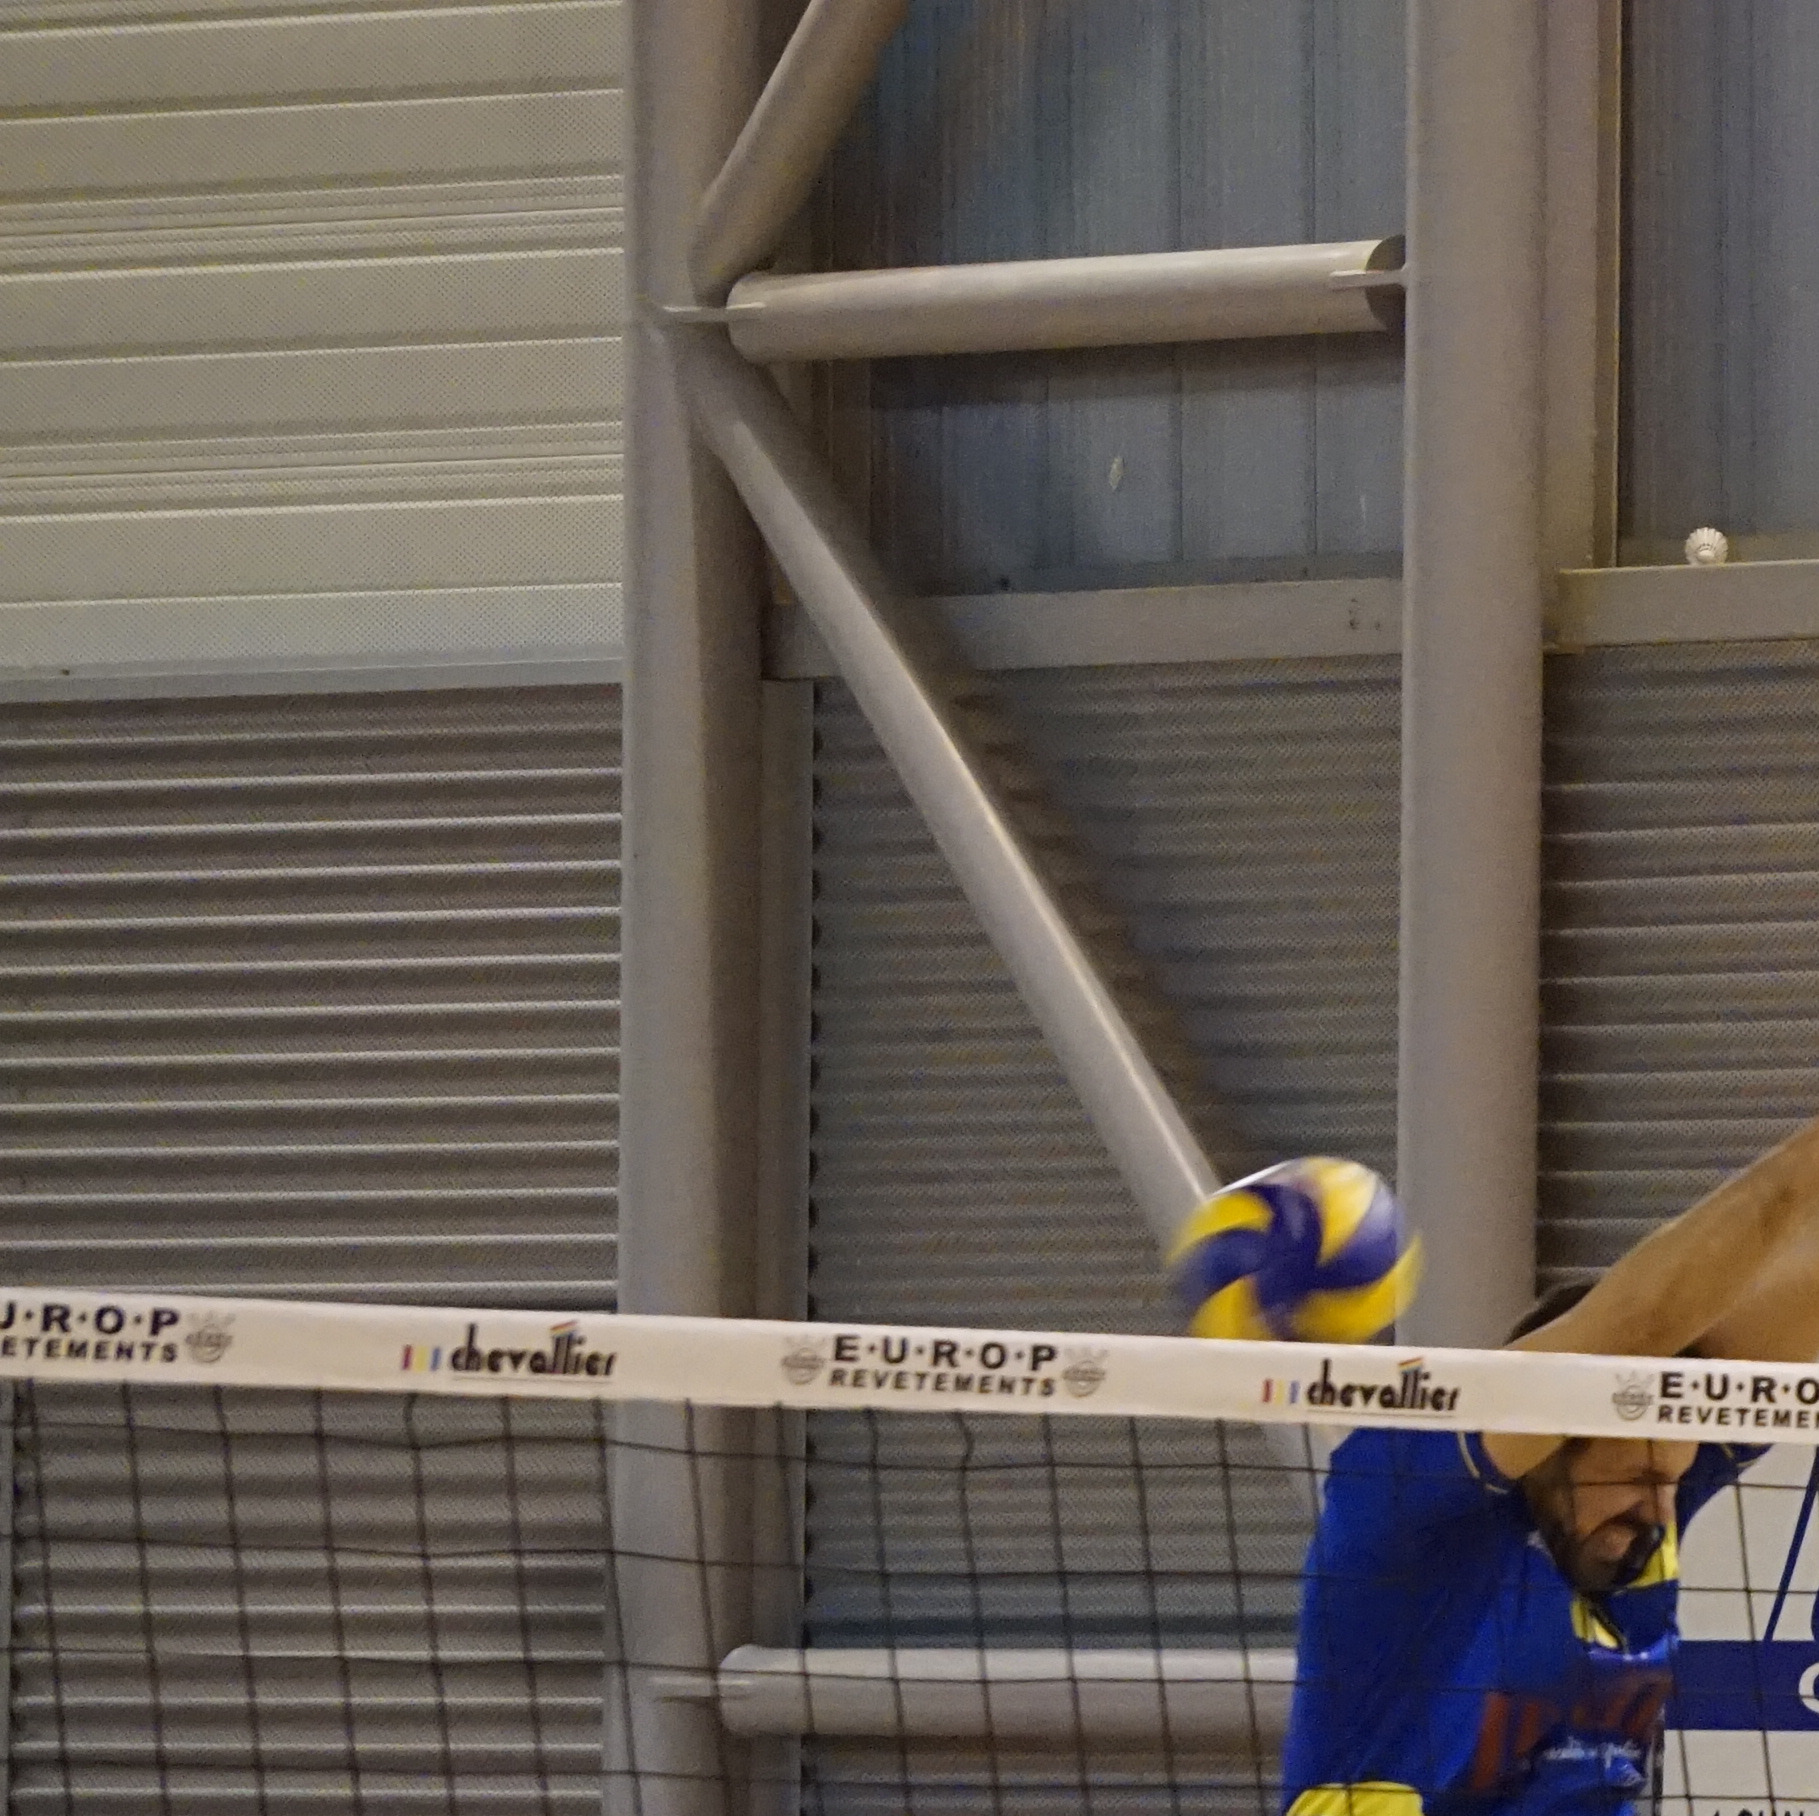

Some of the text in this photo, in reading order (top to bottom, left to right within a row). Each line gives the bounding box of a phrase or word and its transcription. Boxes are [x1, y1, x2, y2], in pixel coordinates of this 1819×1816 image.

[450, 1321, 617, 1377] chevallier
[829, 1367, 1056, 1396] REVETEMENTS
[1307, 1359, 1461, 1412] chevallier
